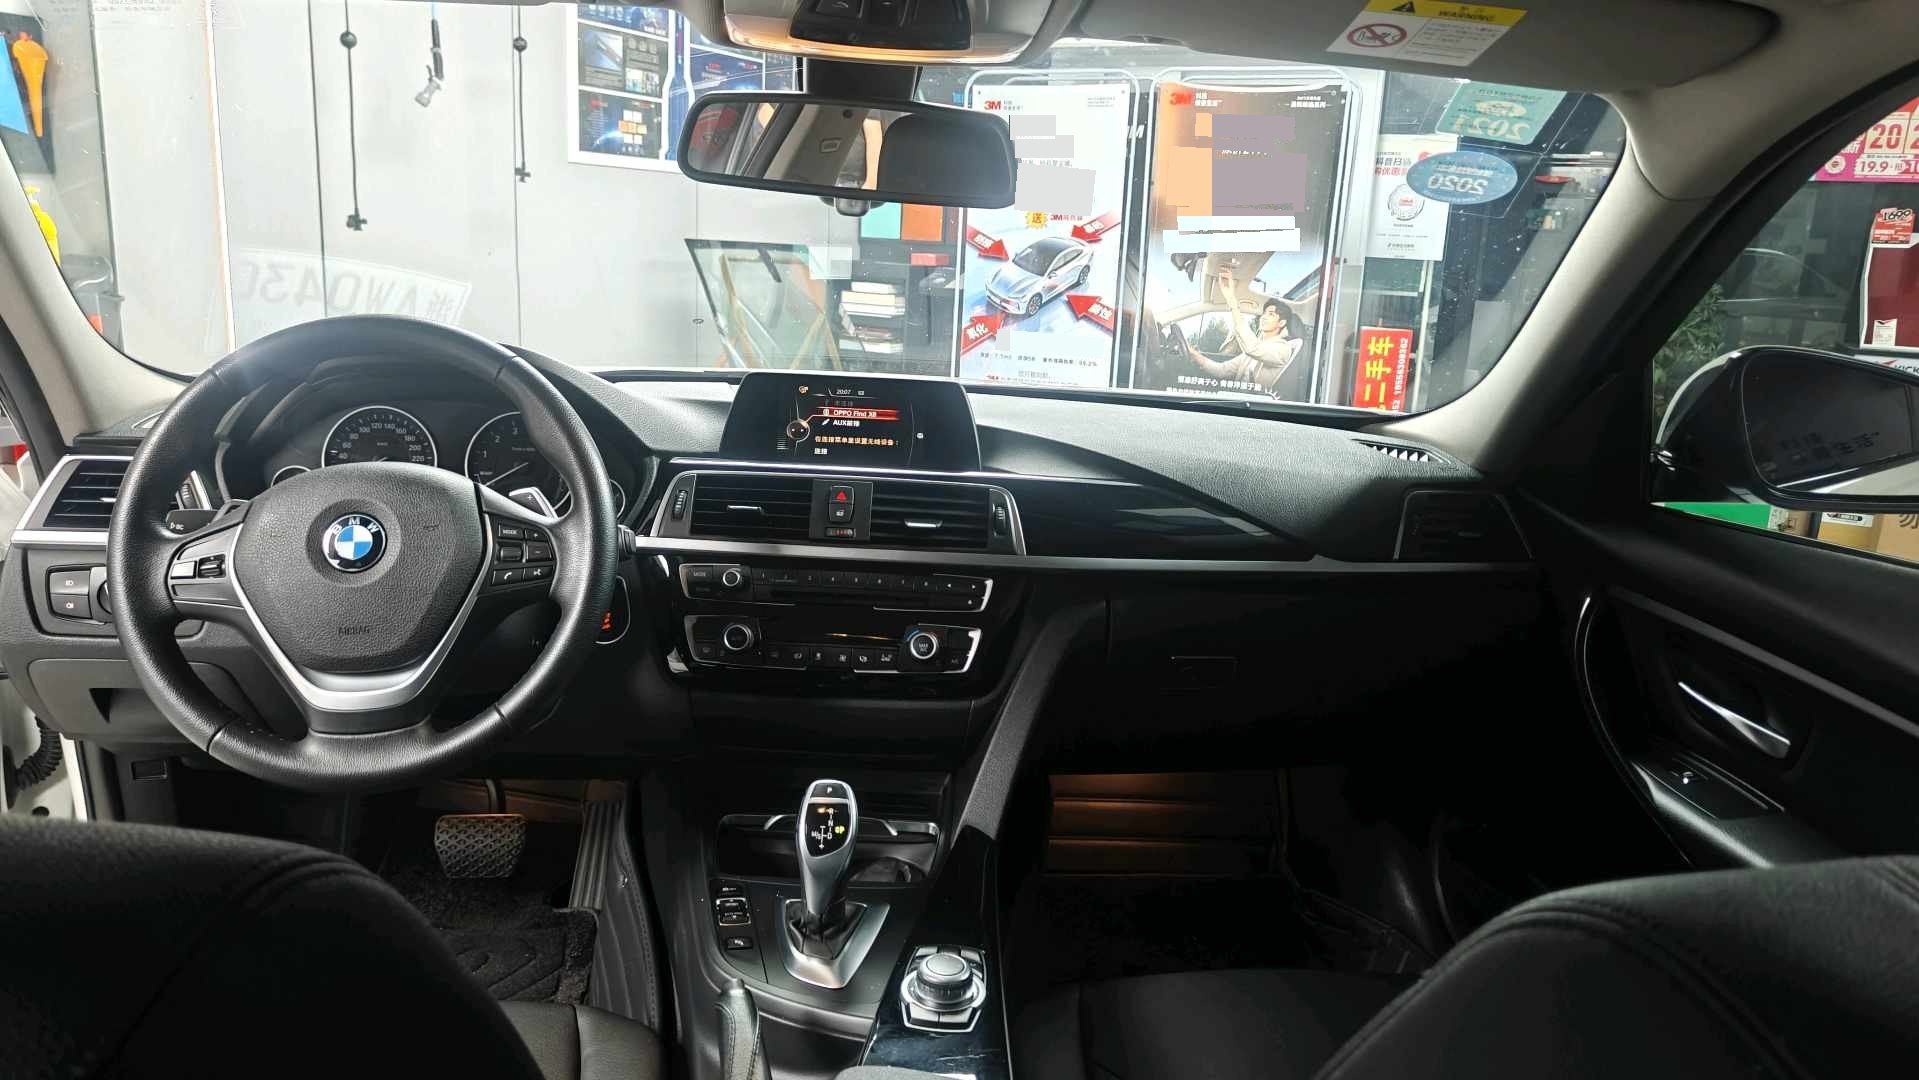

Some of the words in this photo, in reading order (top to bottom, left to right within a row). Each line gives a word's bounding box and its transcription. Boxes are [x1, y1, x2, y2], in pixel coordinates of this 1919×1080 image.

[1170, 92, 1193, 106] 3M
[984, 100, 1001, 111] 3M
[1870, 123, 1903, 149] 20
[1860, 160, 1889, 173] 19.9
[1364, 336, 1394, 402] 二手车
[833, 409, 852, 417] OPPO
[331, 516, 380, 535] BMW
[827, 786, 833, 794] P
[828, 807, 834, 815] R
[828, 819, 834, 827] N
[827, 832, 833, 840] D
